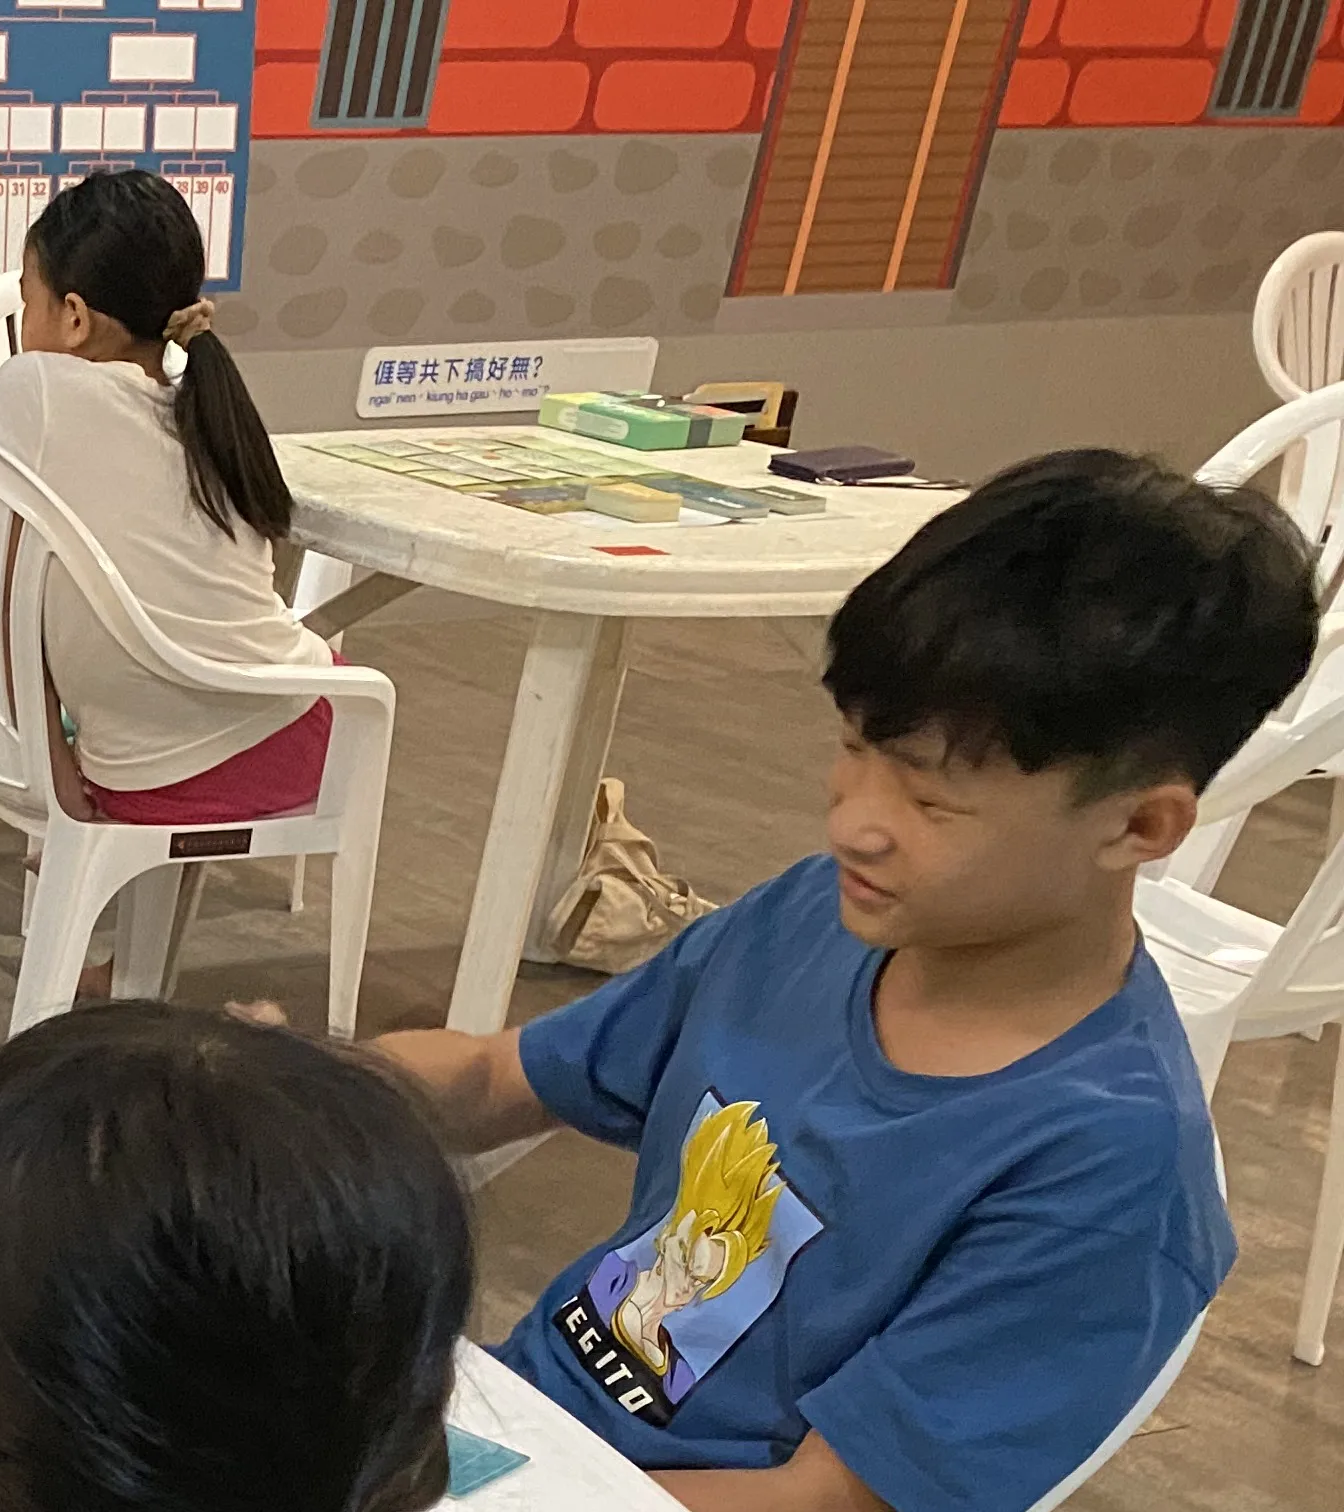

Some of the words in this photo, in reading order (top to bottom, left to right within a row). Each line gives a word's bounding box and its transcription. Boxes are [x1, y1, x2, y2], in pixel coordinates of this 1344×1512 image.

[12, 182, 25, 195] 31
[32, 182, 47, 195] 32
[194, 180, 209, 194] 39
[215, 180, 229, 194] 40
